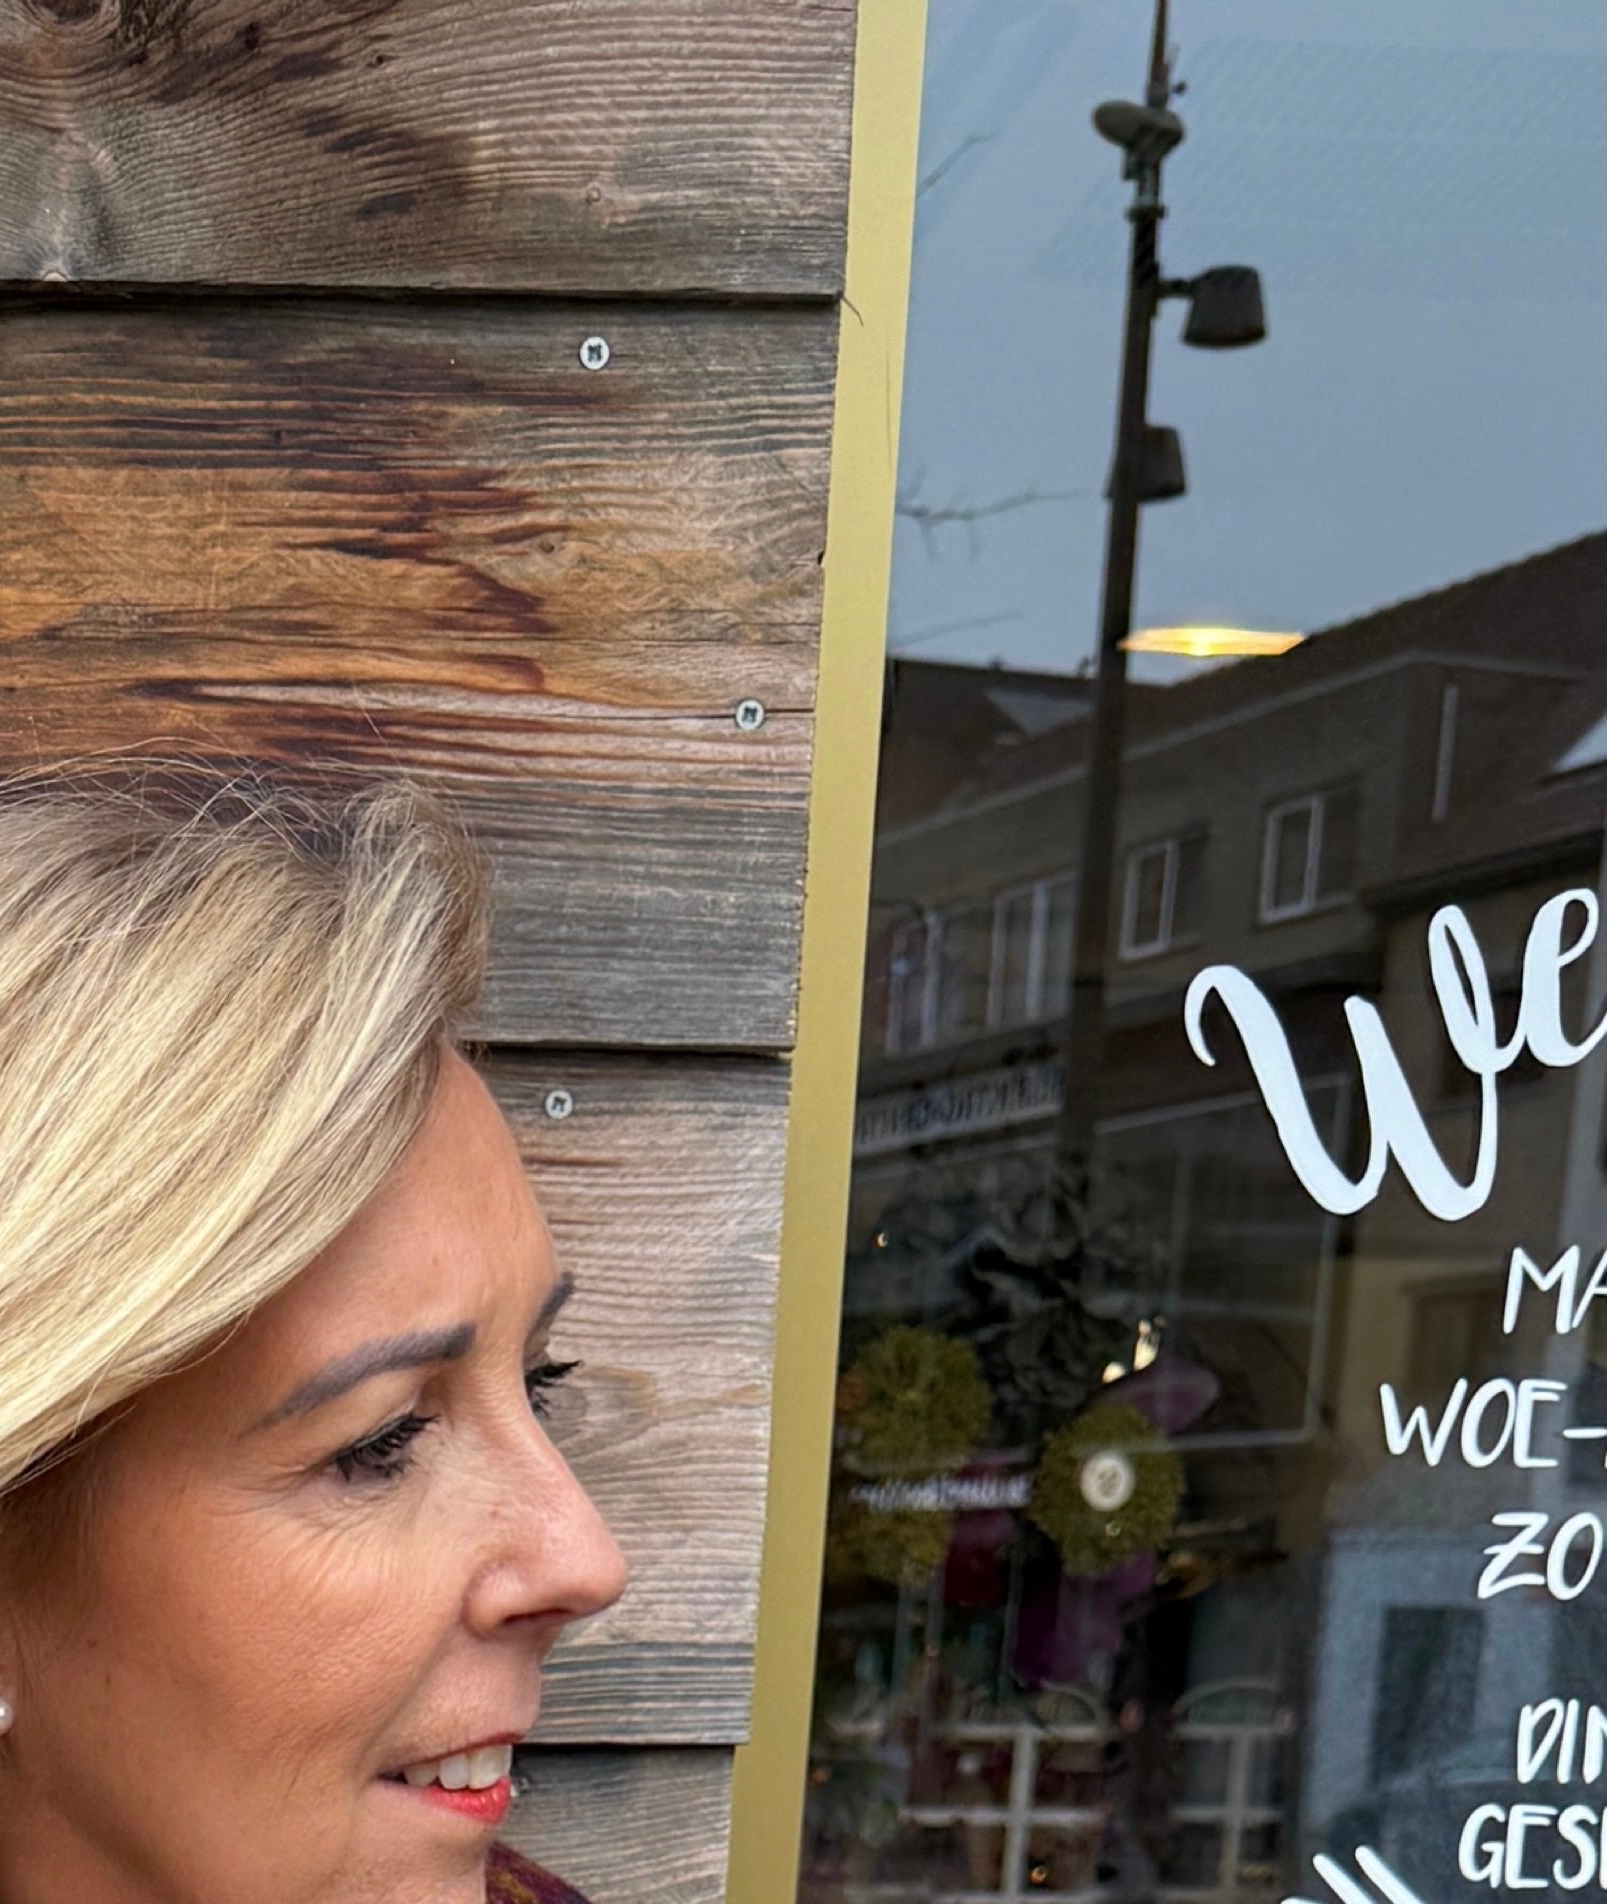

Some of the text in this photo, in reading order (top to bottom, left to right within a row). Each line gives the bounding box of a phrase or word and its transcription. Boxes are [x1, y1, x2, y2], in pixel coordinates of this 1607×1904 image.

[1379, 1378, 1607, 1468] WOE-
[1477, 1512, 1603, 1601] ZO
[1458, 1803, 1607, 1890] GES
